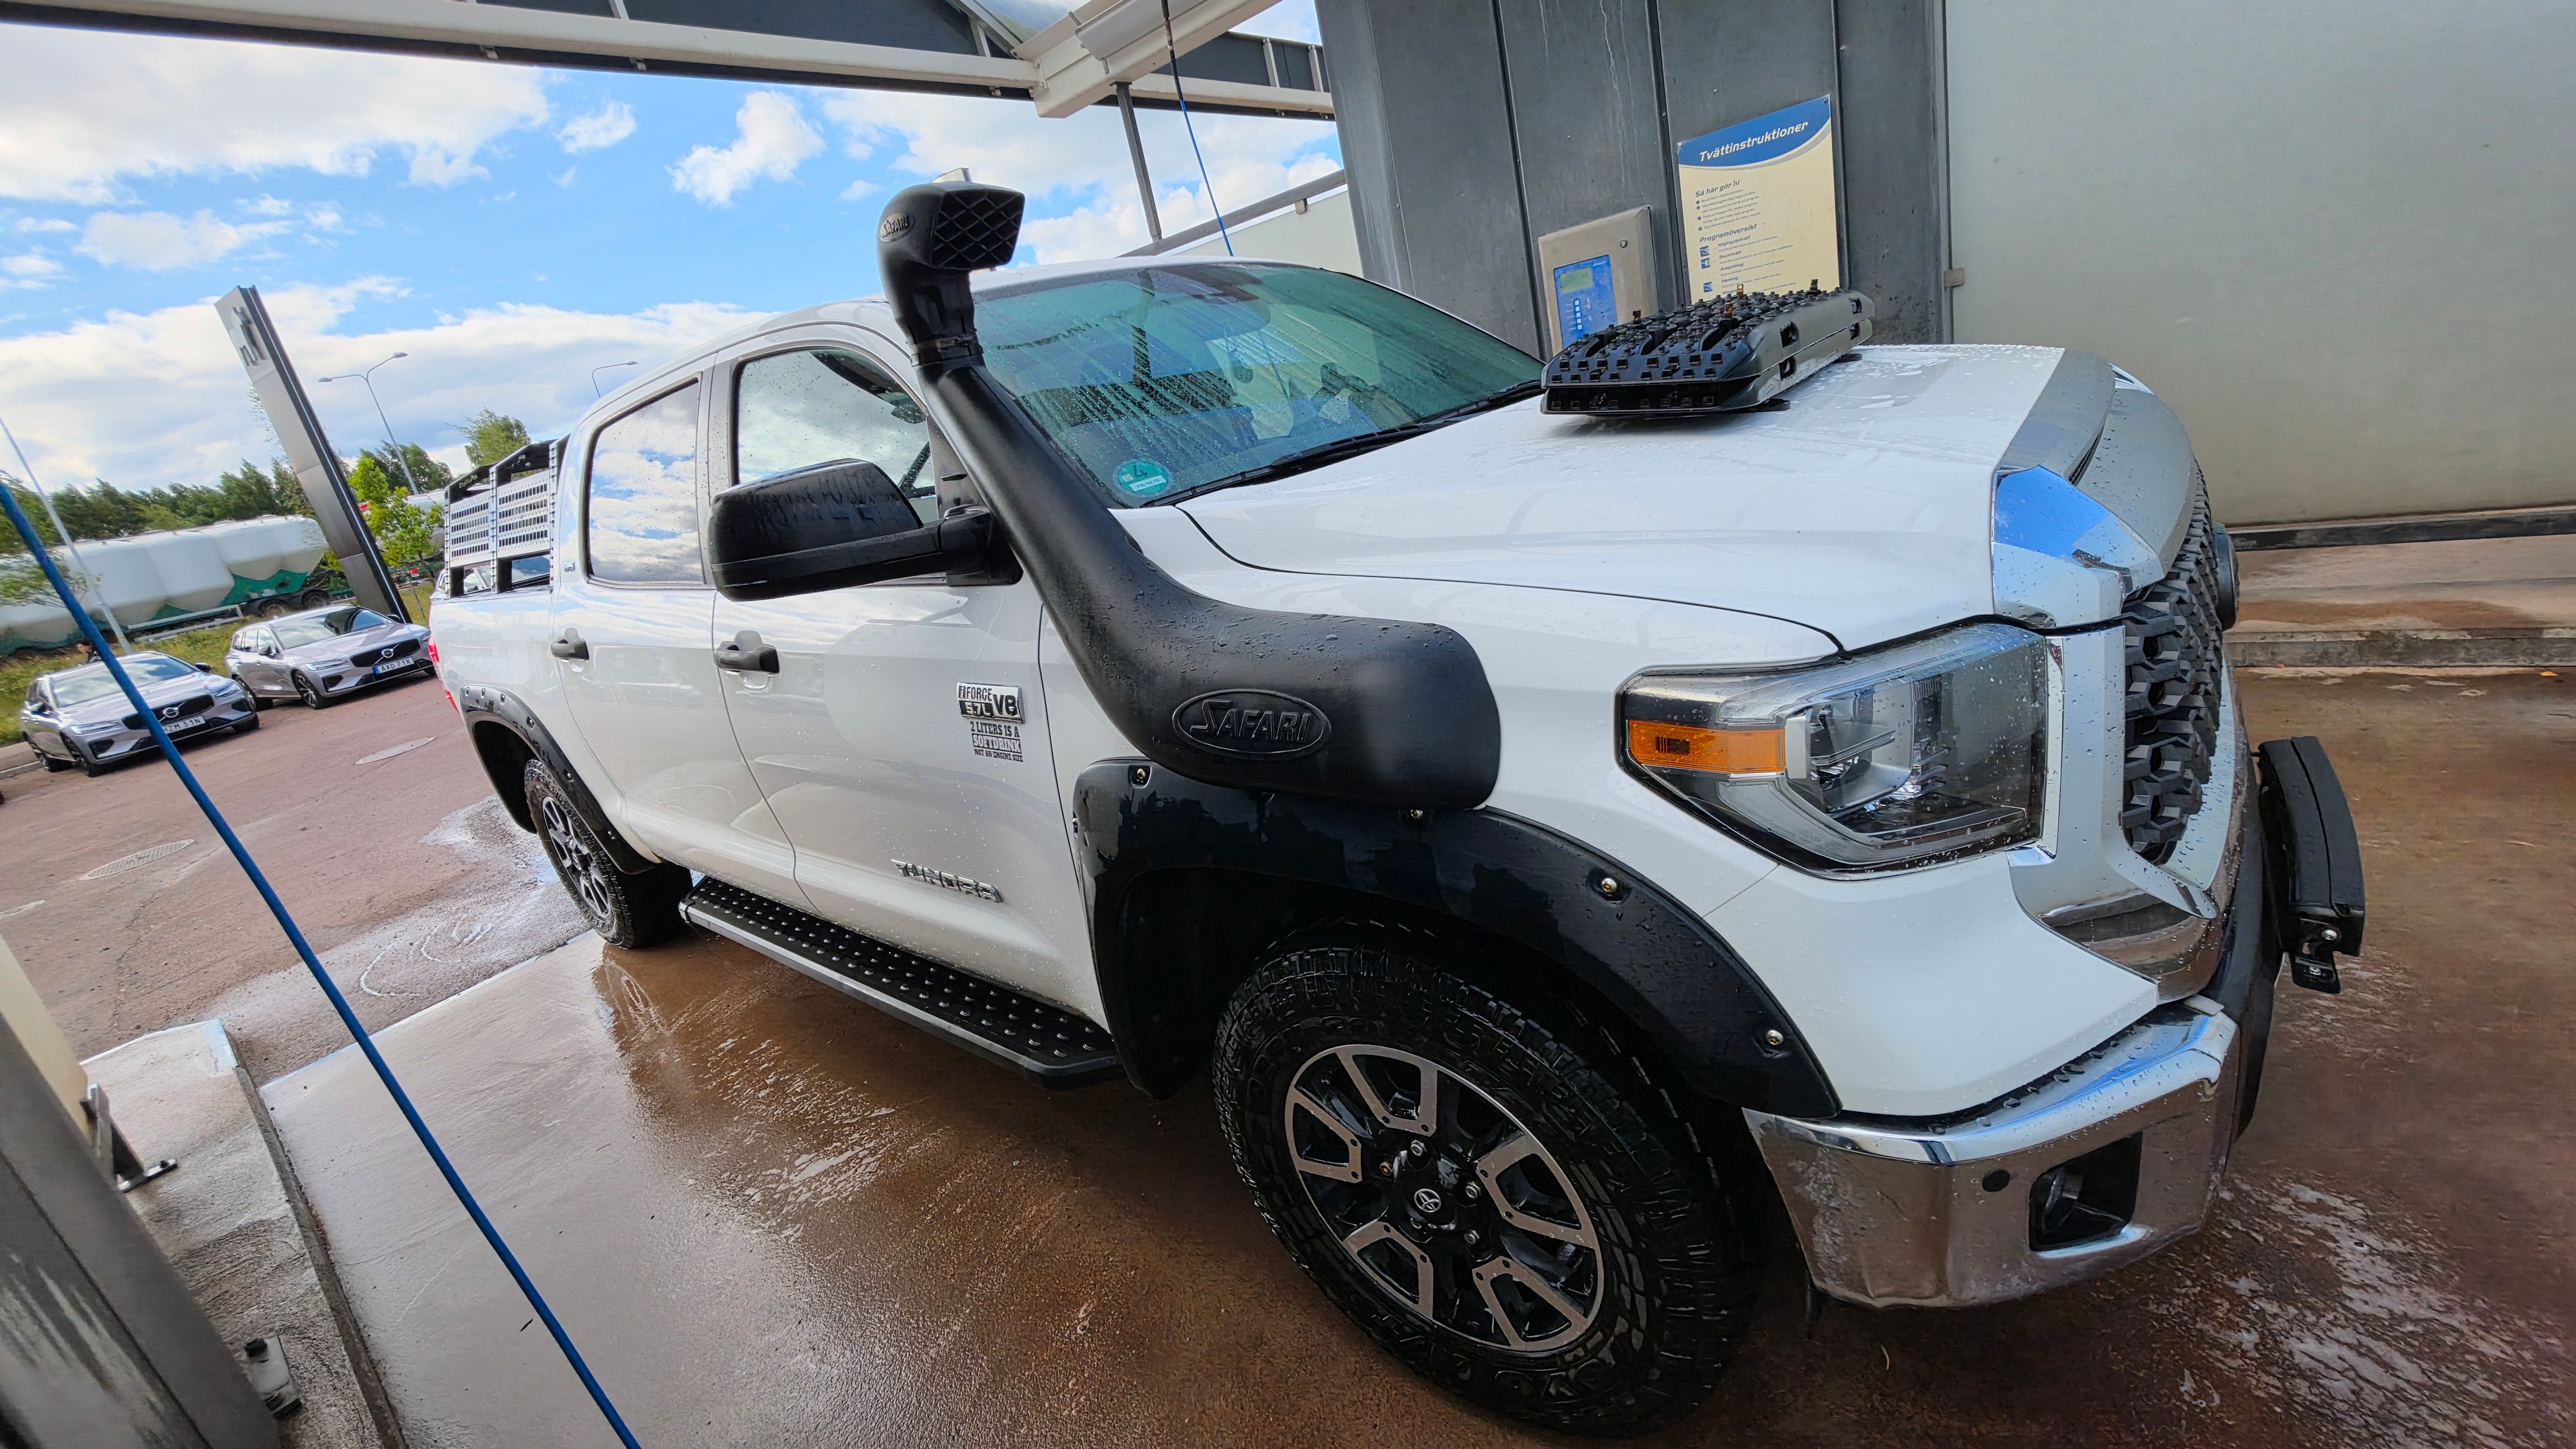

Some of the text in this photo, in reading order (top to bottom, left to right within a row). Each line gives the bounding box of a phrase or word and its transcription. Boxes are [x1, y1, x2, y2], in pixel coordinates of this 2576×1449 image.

[1700, 121, 1808, 162] Tvättinstruktioner
[1695, 189, 1704, 197] Så
[1720, 183, 1731, 192] gör
[883, 215, 909, 238] SAFARI
[1699, 223, 1757, 243] Programöversikt
[381, 659, 411, 672] AXD 71X
[964, 694, 1019, 716] 5.7L V8
[182, 718, 201, 727] 31N
[971, 721, 1020, 738] 2 LITERS IS A
[1190, 699, 1311, 743] SAFARI
[972, 734, 1021, 753] SOFTDRINK
[974, 748, 984, 757] NOT
[993, 751, 1012, 761] ENGINE
